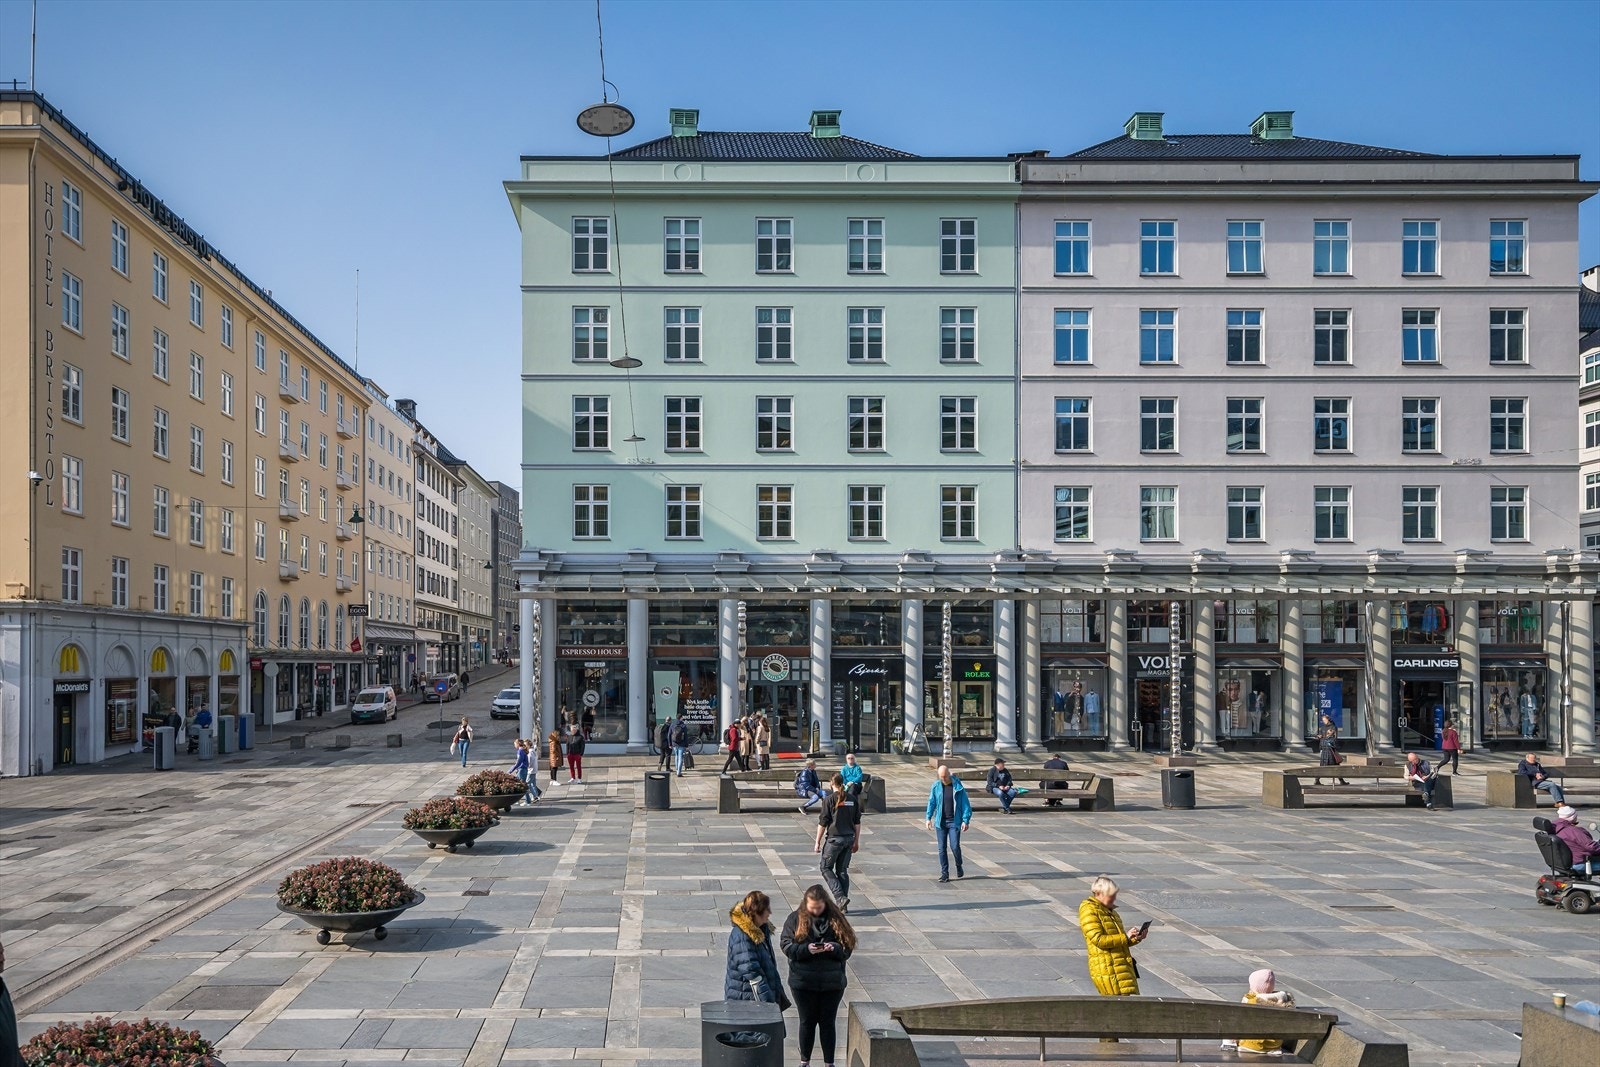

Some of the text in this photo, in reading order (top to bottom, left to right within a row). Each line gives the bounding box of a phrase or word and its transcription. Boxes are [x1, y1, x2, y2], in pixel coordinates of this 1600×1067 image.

[132, 180, 212, 261] HOTEL BRISTOL
[44, 182, 54, 506] HOTEL BRISTOL
[1394, 659, 1459, 668] CARLINGS
[55, 683, 89, 692] McDonald's
